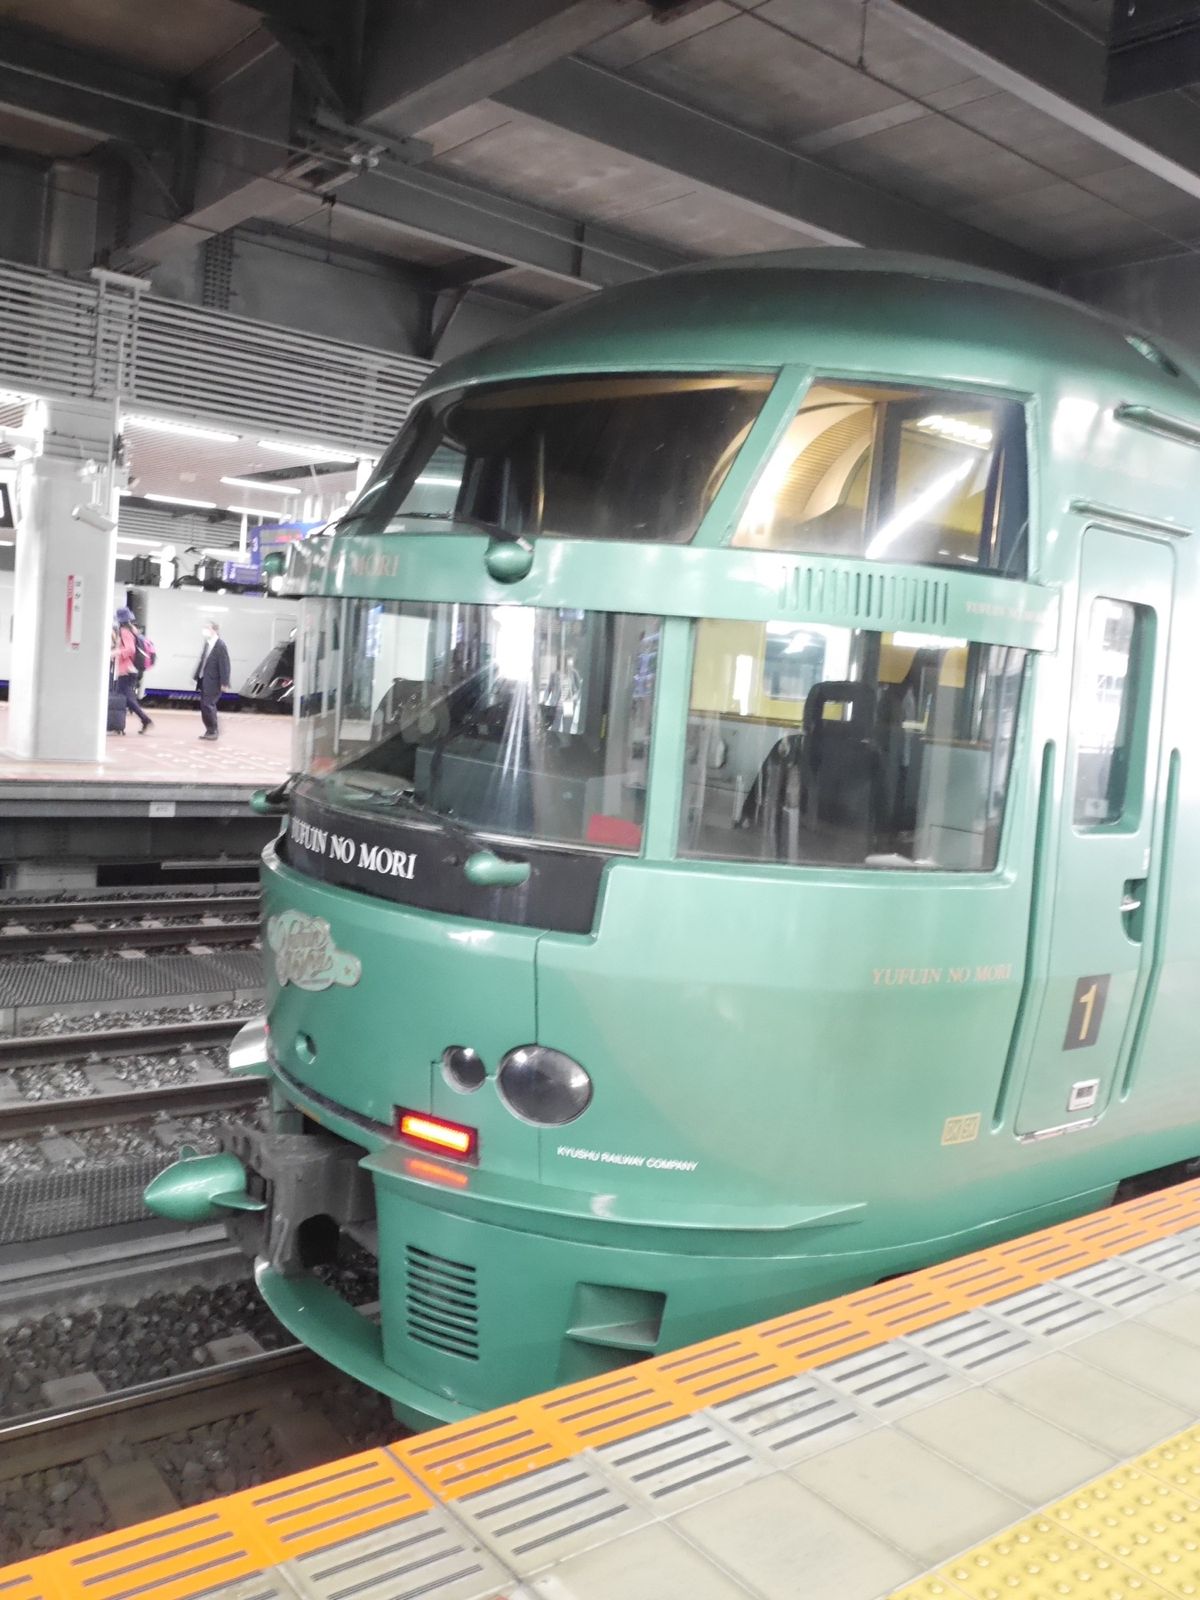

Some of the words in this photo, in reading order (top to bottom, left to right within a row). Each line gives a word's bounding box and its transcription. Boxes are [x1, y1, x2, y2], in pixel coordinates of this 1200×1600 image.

[329, 834, 356, 864] NO
[358, 843, 418, 880] MORI
[872, 967, 943, 985] YUFUIN
[946, 966, 971, 984] NO
[1078, 983, 1098, 1041] 1
[557, 1145, 601, 1162] KYUSHU
[600, 1151, 646, 1167] RAILWAY
[645, 1156, 699, 1172] COMPANY
